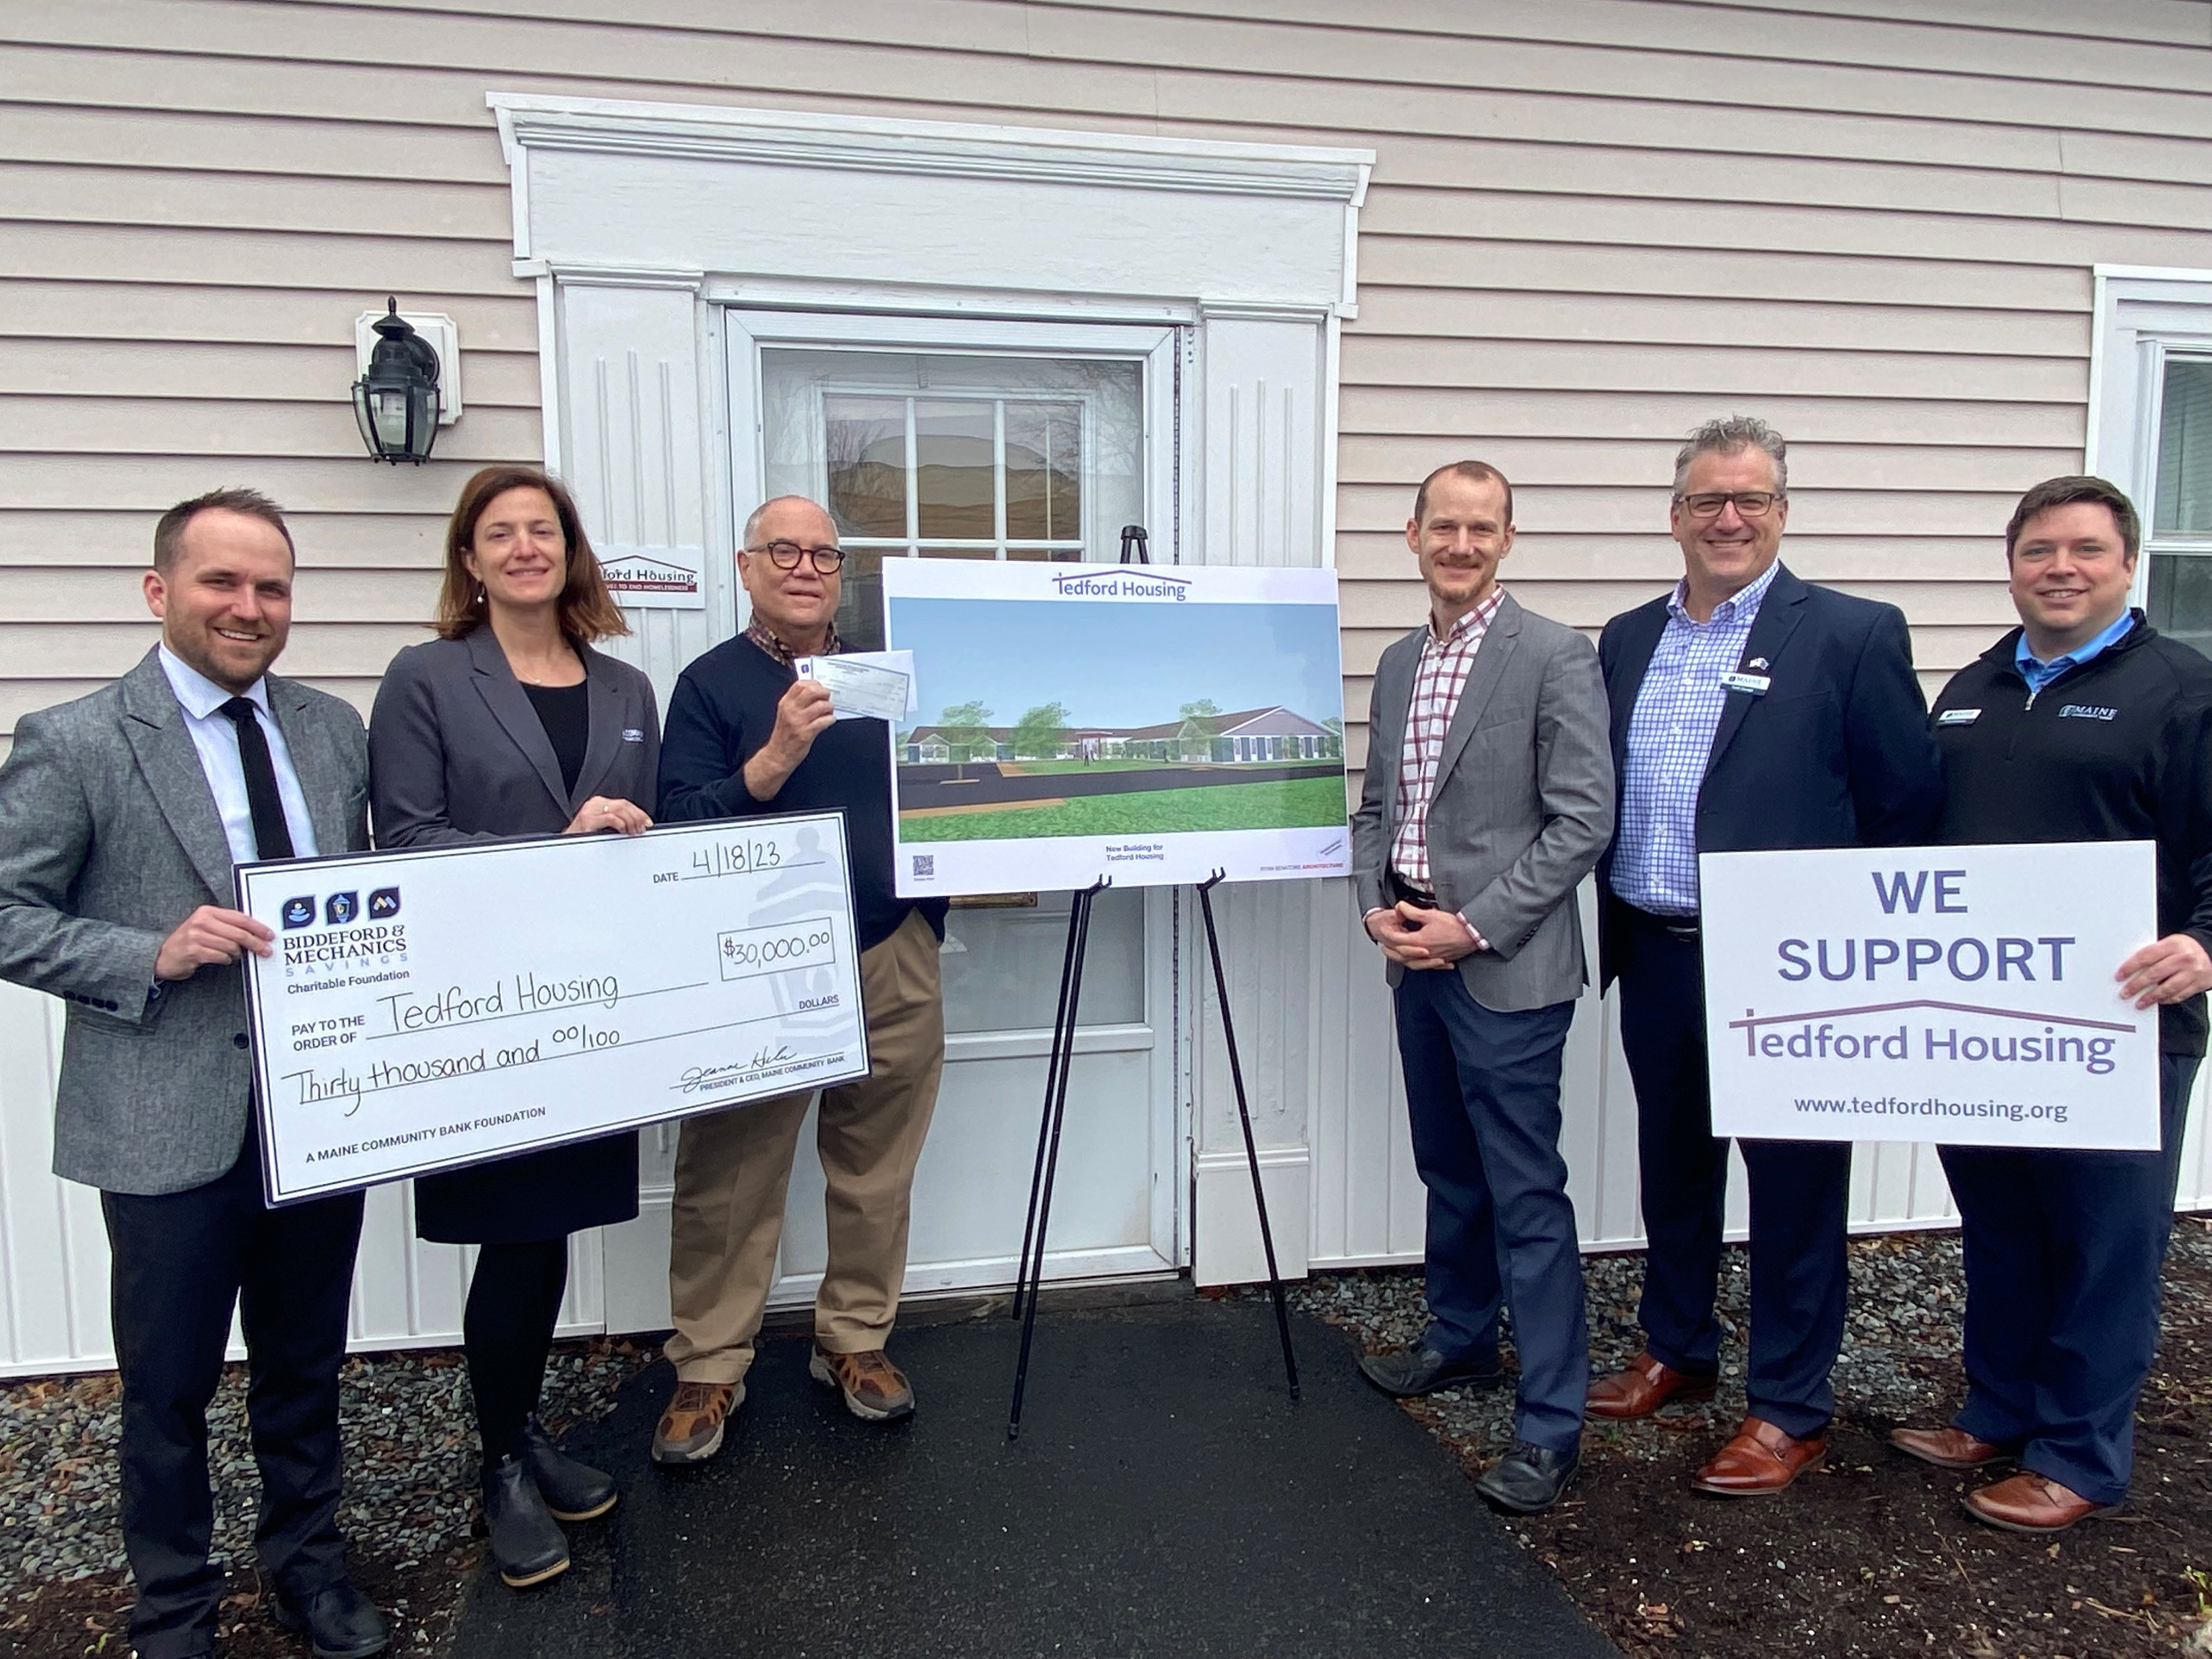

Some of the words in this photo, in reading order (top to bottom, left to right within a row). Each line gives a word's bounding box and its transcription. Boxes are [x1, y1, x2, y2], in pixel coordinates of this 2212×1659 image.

[603, 569, 631, 580] ford
[637, 570, 694, 585] Housing
[1058, 572, 1118, 595] Tedford
[1123, 580, 1186, 602] Housing
[2074, 705, 2117, 717] MAINE
[693, 839, 780, 878] 4/18/23
[653, 872, 679, 883] DATE
[1872, 870, 1968, 914] WE
[283, 926, 388, 950] BIDDEFORD
[392, 925, 405, 937] &
[724, 932, 830, 968] $30,000.00
[285, 938, 407, 965] MECHANICS
[1778, 936, 2076, 981] SUPPORT
[286, 953, 408, 978] SAVINGS
[288, 978, 346, 995] Charitable
[349, 970, 410, 987] Foundation
[375, 980, 503, 1033] Tedford
[516, 970, 619, 1010] Housing
[799, 995, 840, 1010] DOLLARS
[291, 1021, 316, 1036] PAY
[319, 1020, 337, 1033] TO
[340, 1016, 365, 1029] THE
[293, 1035, 337, 1052] ORDER
[340, 1033, 357, 1045] OF
[1747, 1008, 1908, 1059] Tedford
[1925, 1026, 2116, 1074] Housing
[280, 1067, 361, 1118] Thirty
[367, 1048, 487, 1089] thousand
[496, 1039, 541, 1068] and
[552, 1024, 620, 1049] 00/100
[700, 1078, 739, 1092] PRESIDENT
[762, 1068, 784, 1079] MAINE
[785, 1058, 826, 1073] COMMUNITY
[826, 1055, 845, 1065] BANK
[1793, 1096, 2068, 1123] www.tedfordhousing.org
[306, 1152, 315, 1164] A
[318, 1144, 358, 1161] MAINE
[361, 1129, 436, 1152] COMMUNITY
[439, 1120, 472, 1136] BANK
[474, 1106, 546, 1130] FOUNDATION
